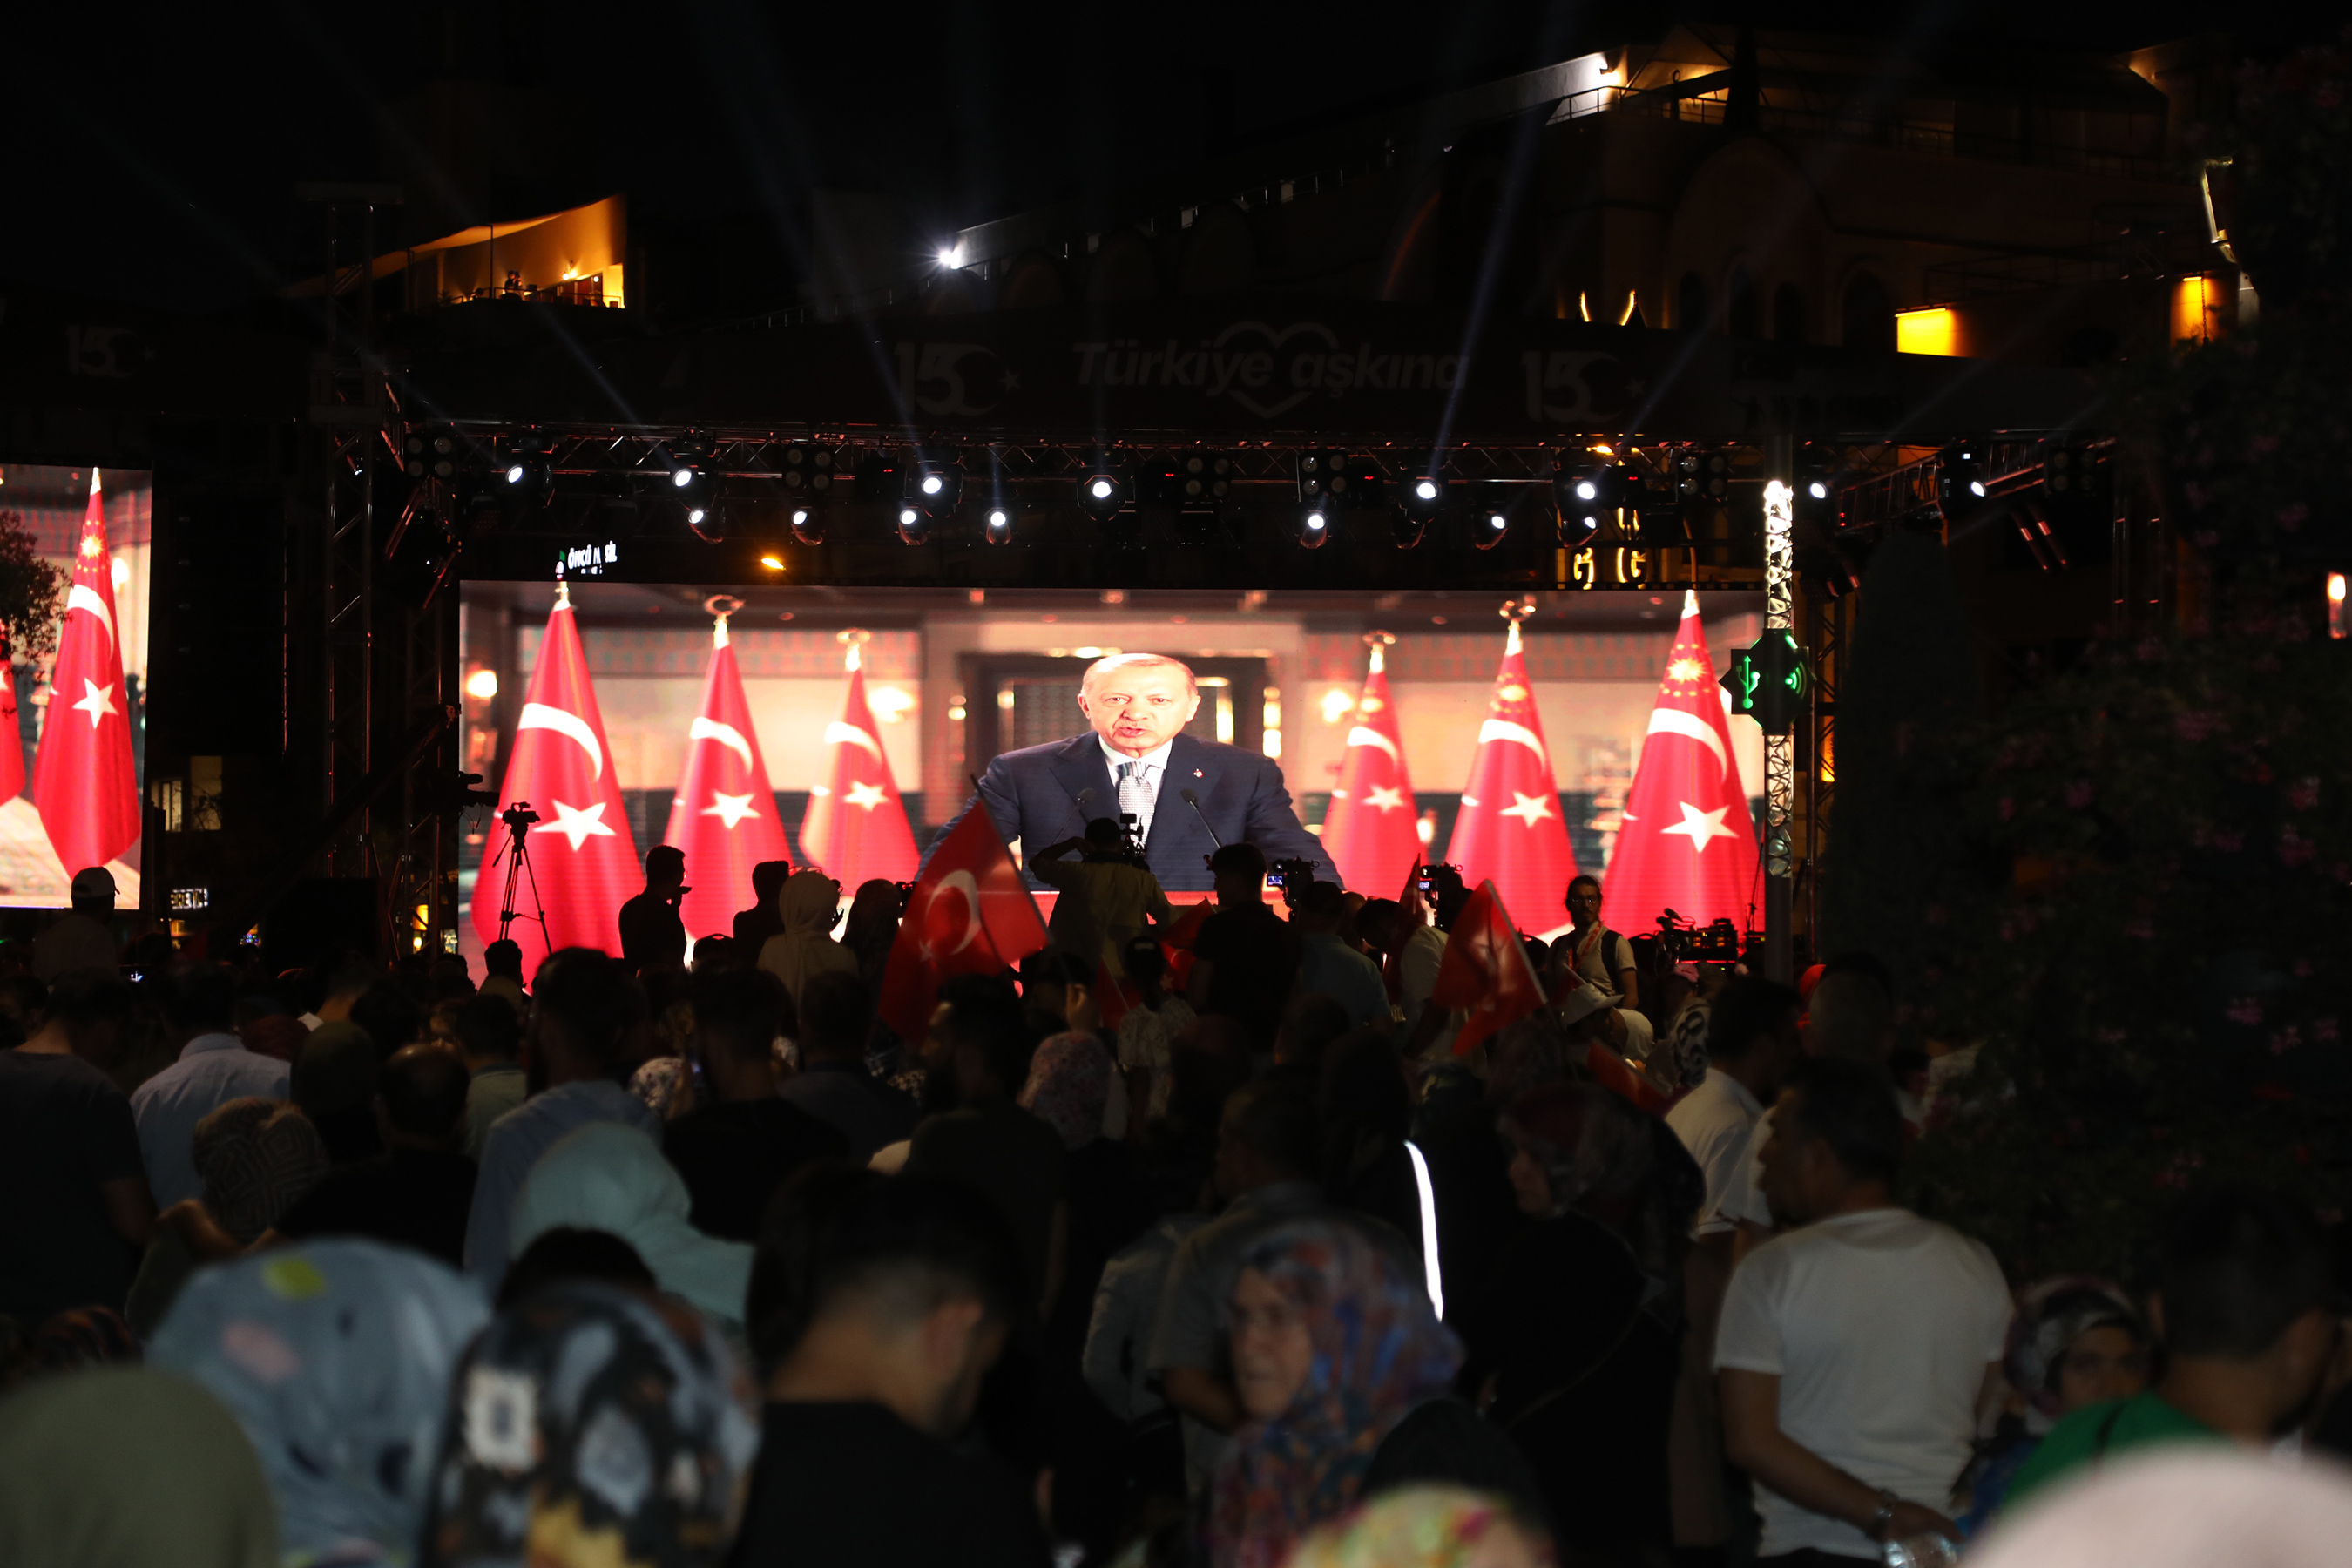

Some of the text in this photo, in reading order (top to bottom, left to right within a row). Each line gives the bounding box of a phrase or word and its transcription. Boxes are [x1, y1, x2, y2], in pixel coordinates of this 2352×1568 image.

[65, 324, 122, 378] 15
[894, 341, 971, 416] 15
[1071, 338, 1470, 399] Türkiye aşkına
[1521, 349, 1598, 424] 15
